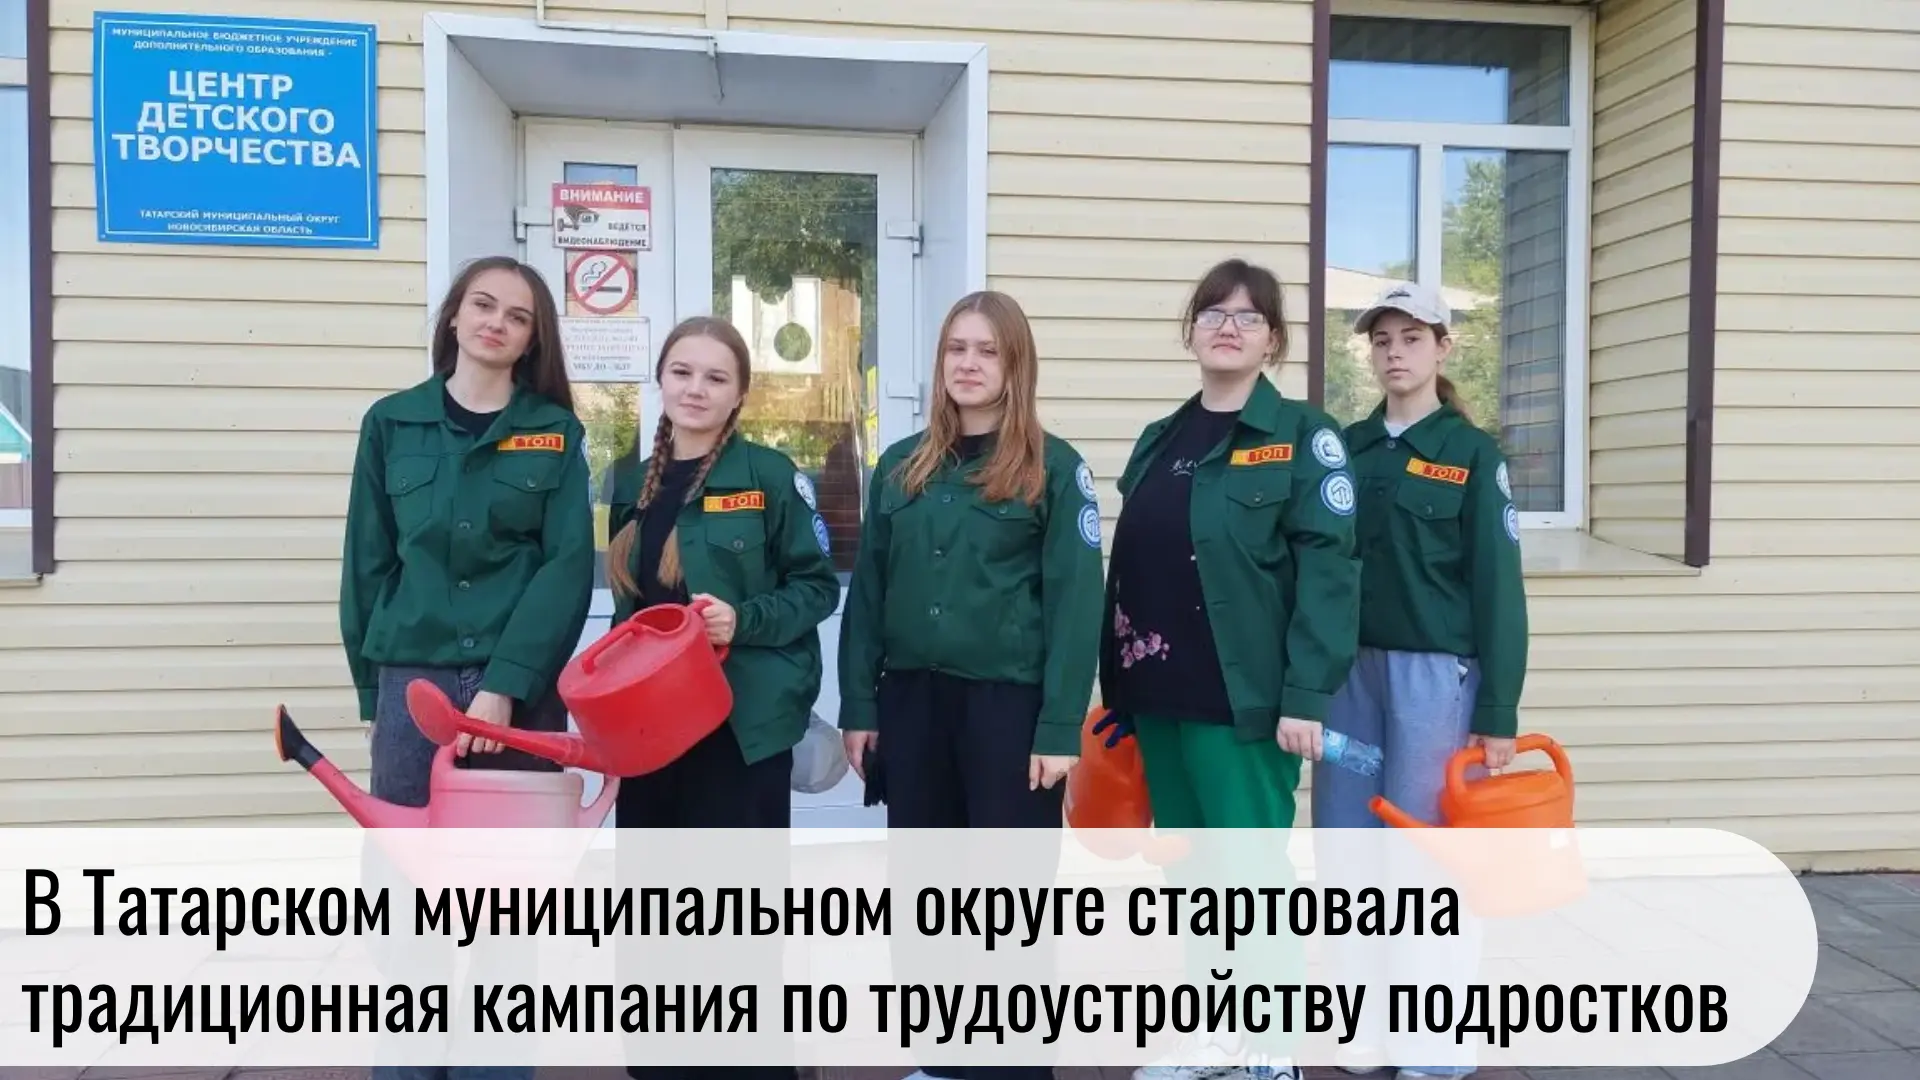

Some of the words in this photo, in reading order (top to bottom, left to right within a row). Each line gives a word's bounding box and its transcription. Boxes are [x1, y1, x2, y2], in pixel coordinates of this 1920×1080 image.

[112, 27, 209, 40] МУНИЦИПАЛЬНОЕ
[213, 32, 282, 43] БЮДЖЕТНОЕ
[286, 35, 358, 47] УЧРЕЖДЕНИЕ
[133, 40, 244, 54] ДОПОЛНИТЕЛЬНОГО
[246, 45, 324, 57] ОБРАЗОВАНИЯ
[168, 70, 293, 101] ЦЕНТР
[137, 102, 335, 135] ДЕТСКОГО
[111, 134, 361, 168] ТВОРЧЕСТВА
[560, 189, 645, 204] ВНИМАНИЕ
[140, 209, 199, 219] ТАТАРСКИЙ
[203, 211, 302, 222] МУНИЦИПАЛЬНЫЙ
[306, 214, 340, 224] ОКРУГ
[167, 223, 260, 233] НОВОСИБИРСКАЯ
[263, 226, 313, 235] ОБЛАСТЬ
[558, 236, 647, 247] ВИДЕОНАБЛЮДЕНИЕ
[525, 437, 557, 447] ТОП
[1255, 447, 1284, 461] ТОП
[1431, 468, 1460, 480] ТОП
[729, 494, 760, 507] ТОП
